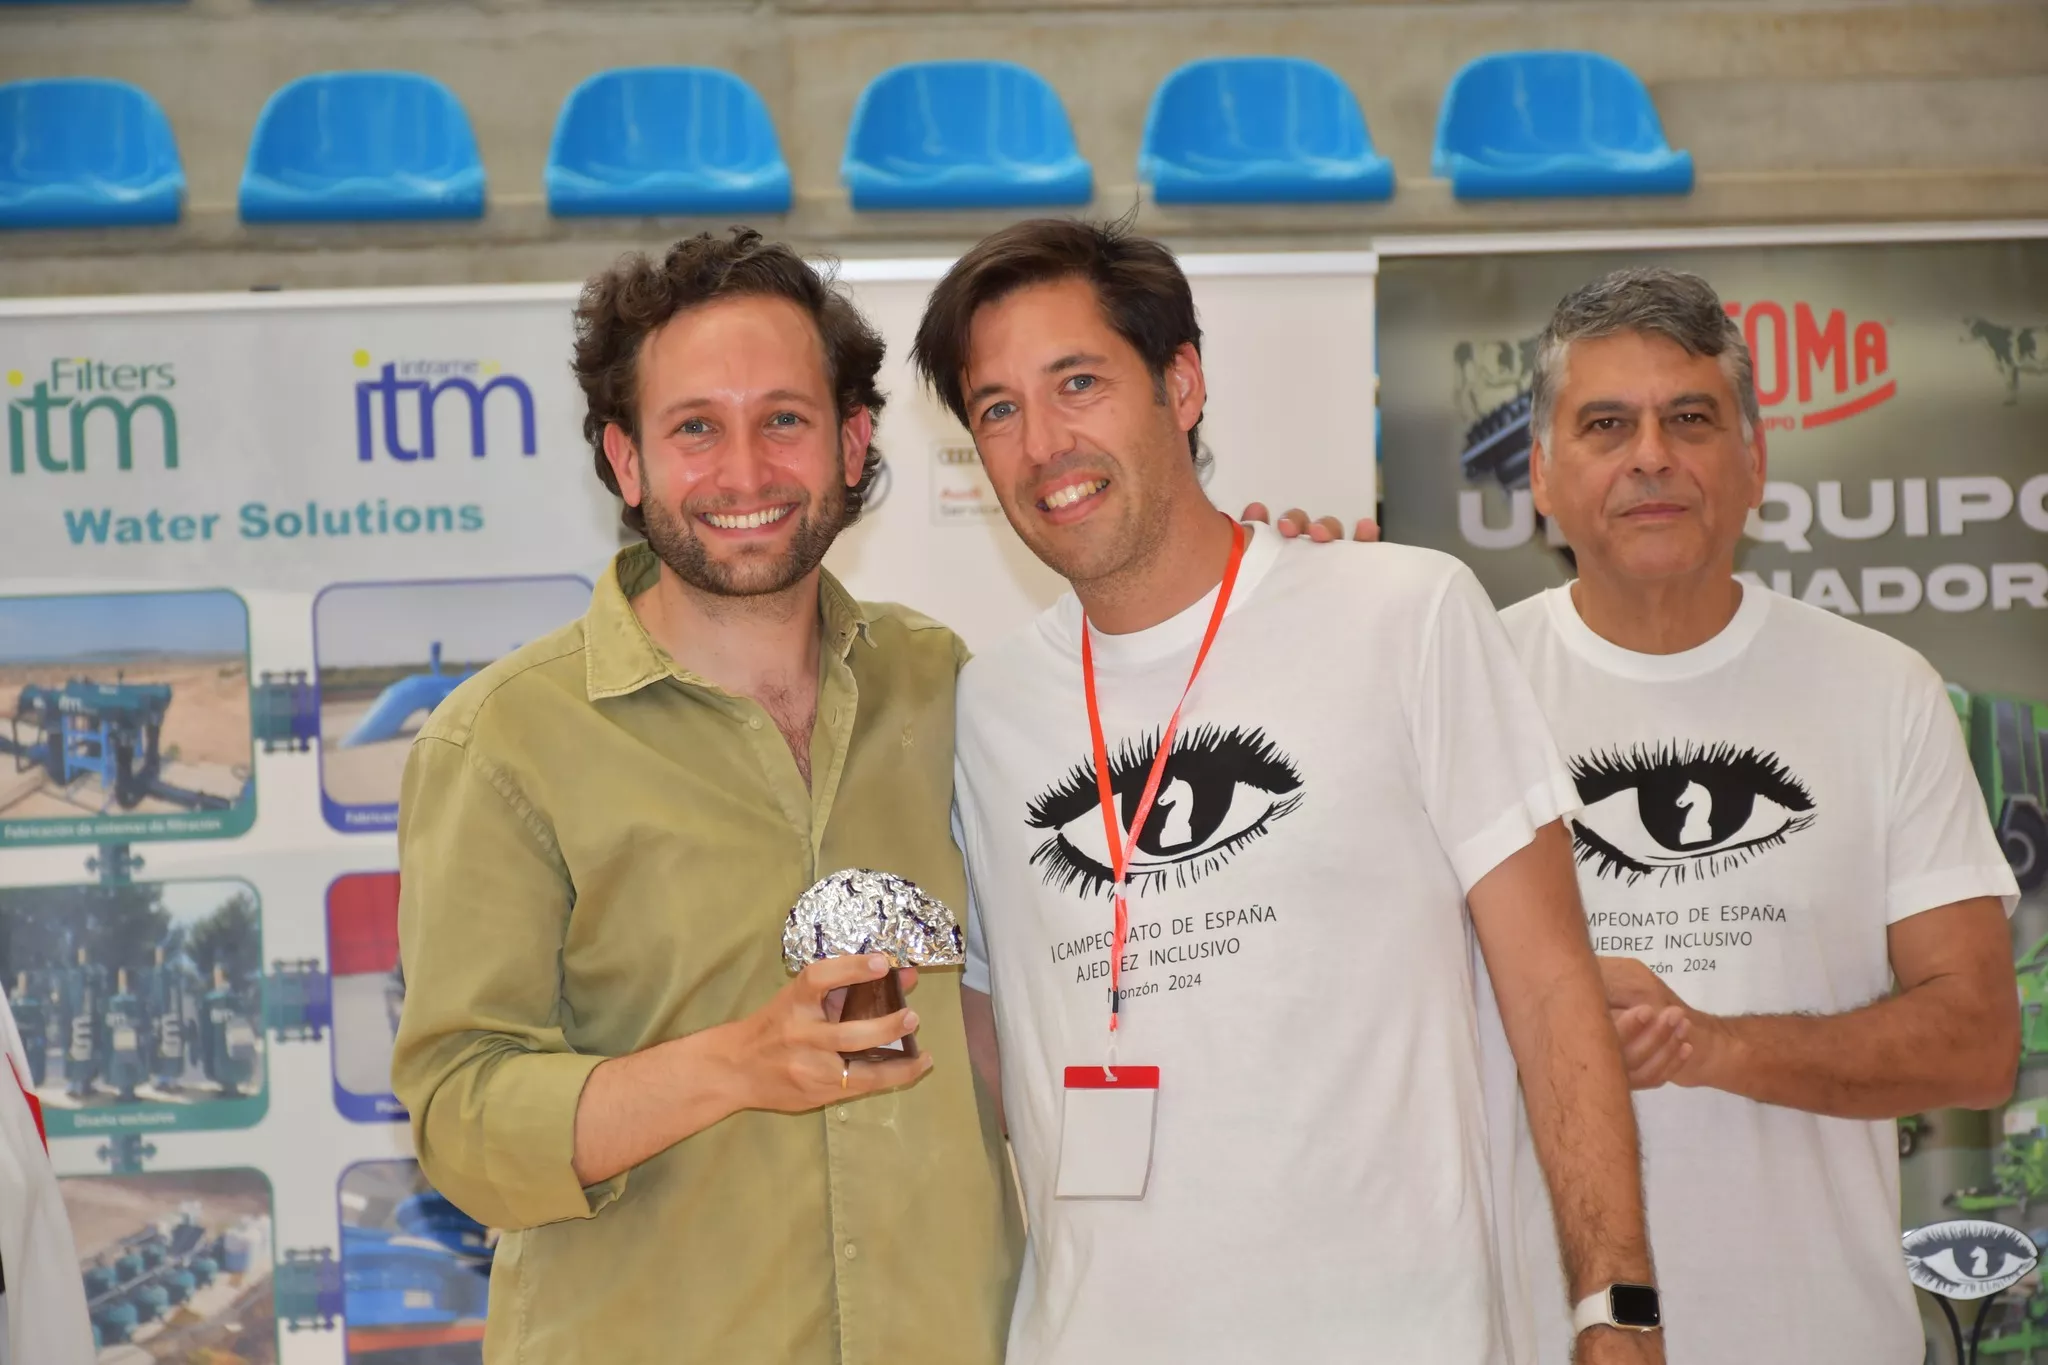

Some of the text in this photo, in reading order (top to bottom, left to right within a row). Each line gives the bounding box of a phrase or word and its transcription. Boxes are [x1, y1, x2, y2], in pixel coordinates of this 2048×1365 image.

[52, 357, 176, 391] Filters
[1724, 301, 1888, 406] OMA
[7, 369, 179, 475] itm
[353, 349, 537, 462] itm
[64, 498, 485, 545] Water Solutions
[1057, 922, 1162, 961] CAMPEOATO
[1172, 916, 1194, 935] DE
[1205, 904, 1277, 930] ESPAÑA
[1689, 907, 1710, 923] DE
[1721, 904, 1787, 922] ESPAÑA
[1076, 937, 1240, 984] AJEDEZ INCLUSIVO
[1665, 931, 1753, 949] INCLUSIVO
[1168, 973, 1203, 992] 2024
[1683, 958, 1716, 972] 2024
